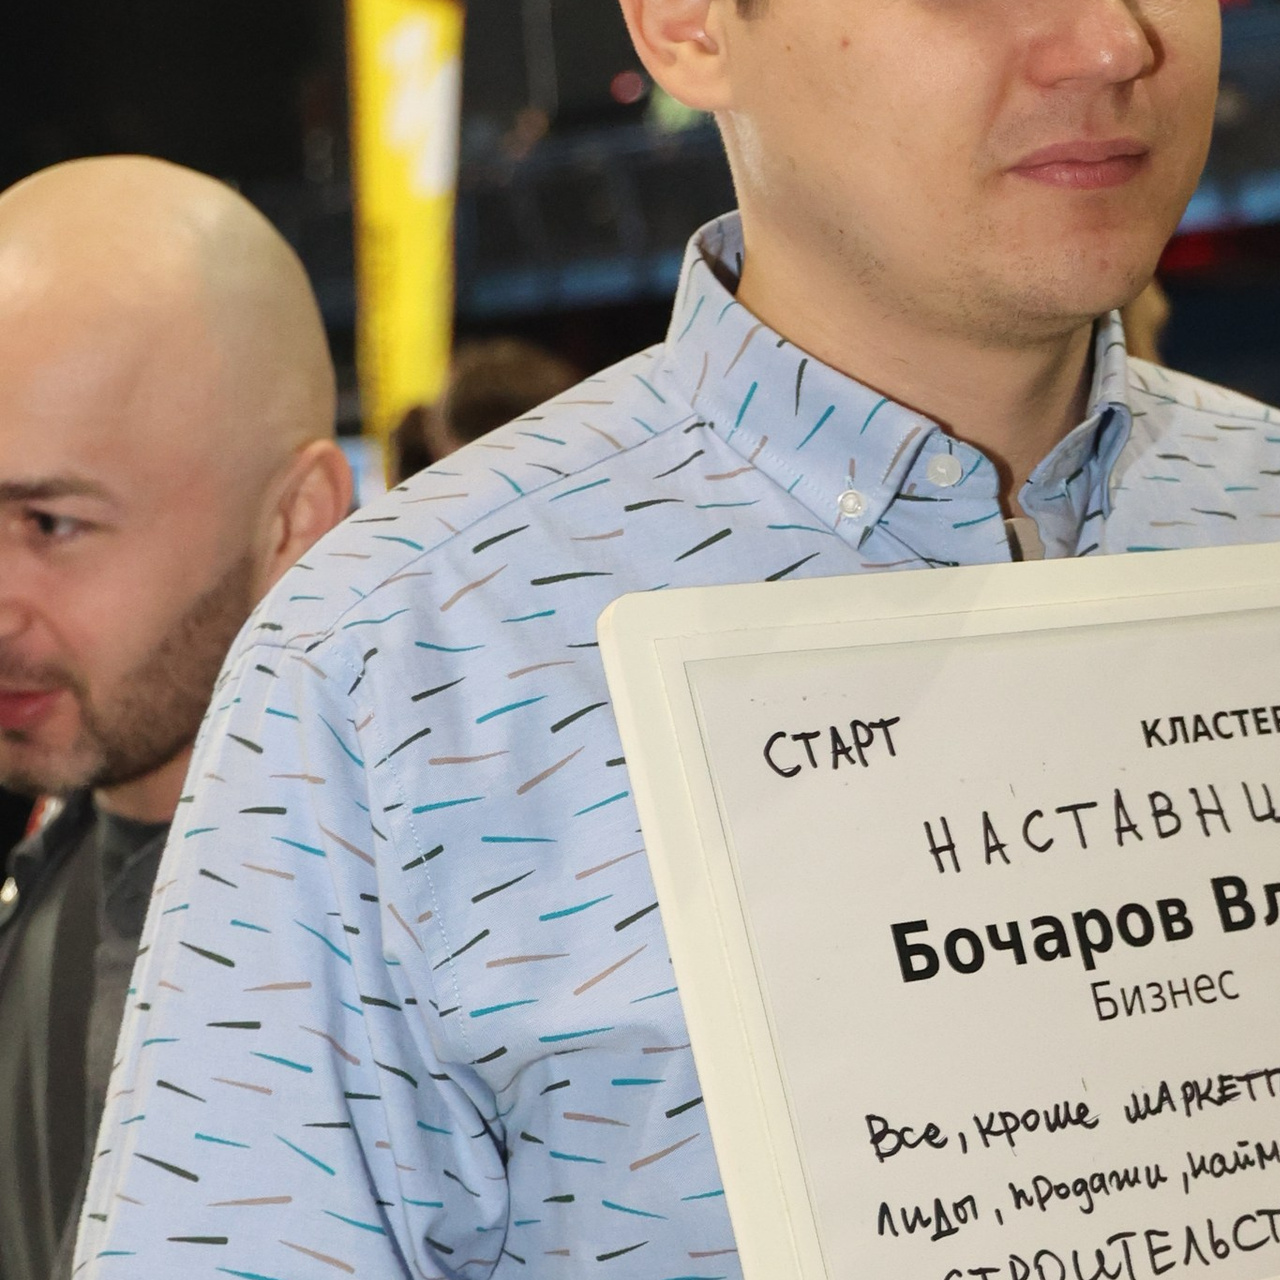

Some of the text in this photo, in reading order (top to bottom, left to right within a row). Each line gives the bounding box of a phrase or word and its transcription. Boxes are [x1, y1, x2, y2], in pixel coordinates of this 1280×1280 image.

[763, 716, 900, 778] СТАРТ
[890, 897, 1194, 983] Бочаров
[1090, 970, 1240, 1021] Бизнес
